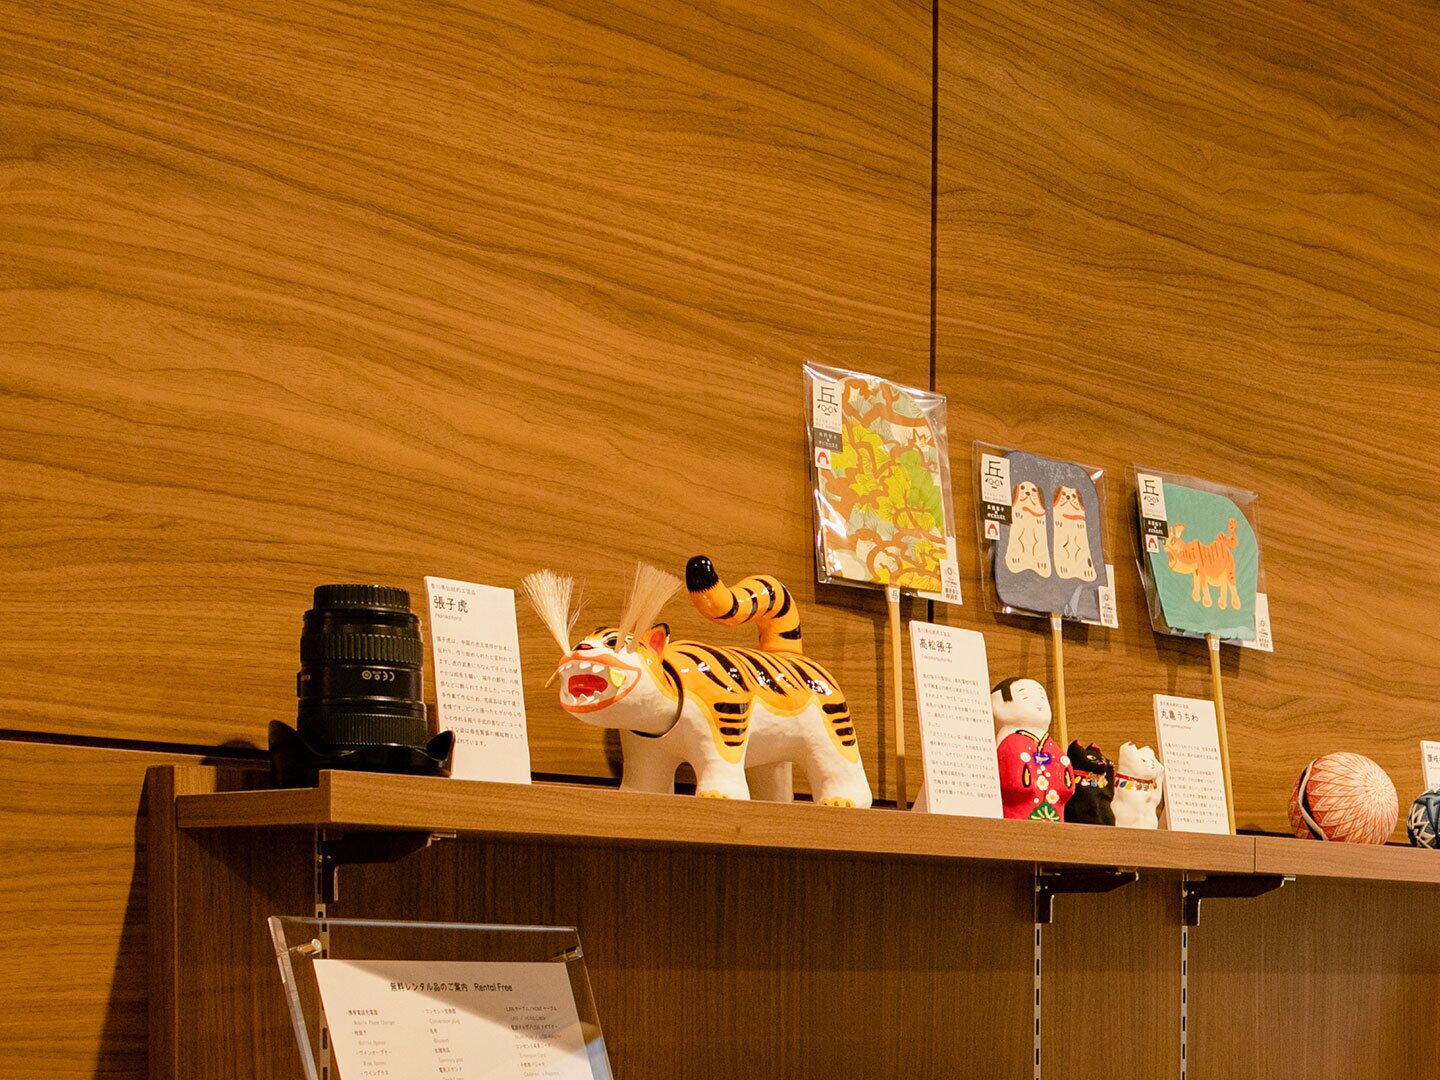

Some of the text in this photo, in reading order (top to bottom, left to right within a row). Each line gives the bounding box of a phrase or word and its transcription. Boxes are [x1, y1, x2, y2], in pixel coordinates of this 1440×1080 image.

[433, 595, 468, 613] 張子虎
[919, 638, 952, 653] 高松張子
[1160, 709, 1199, 722] 丸亀うちわ
[390, 982, 513, 992] 無料レンタル品のご案内 Rental Free
